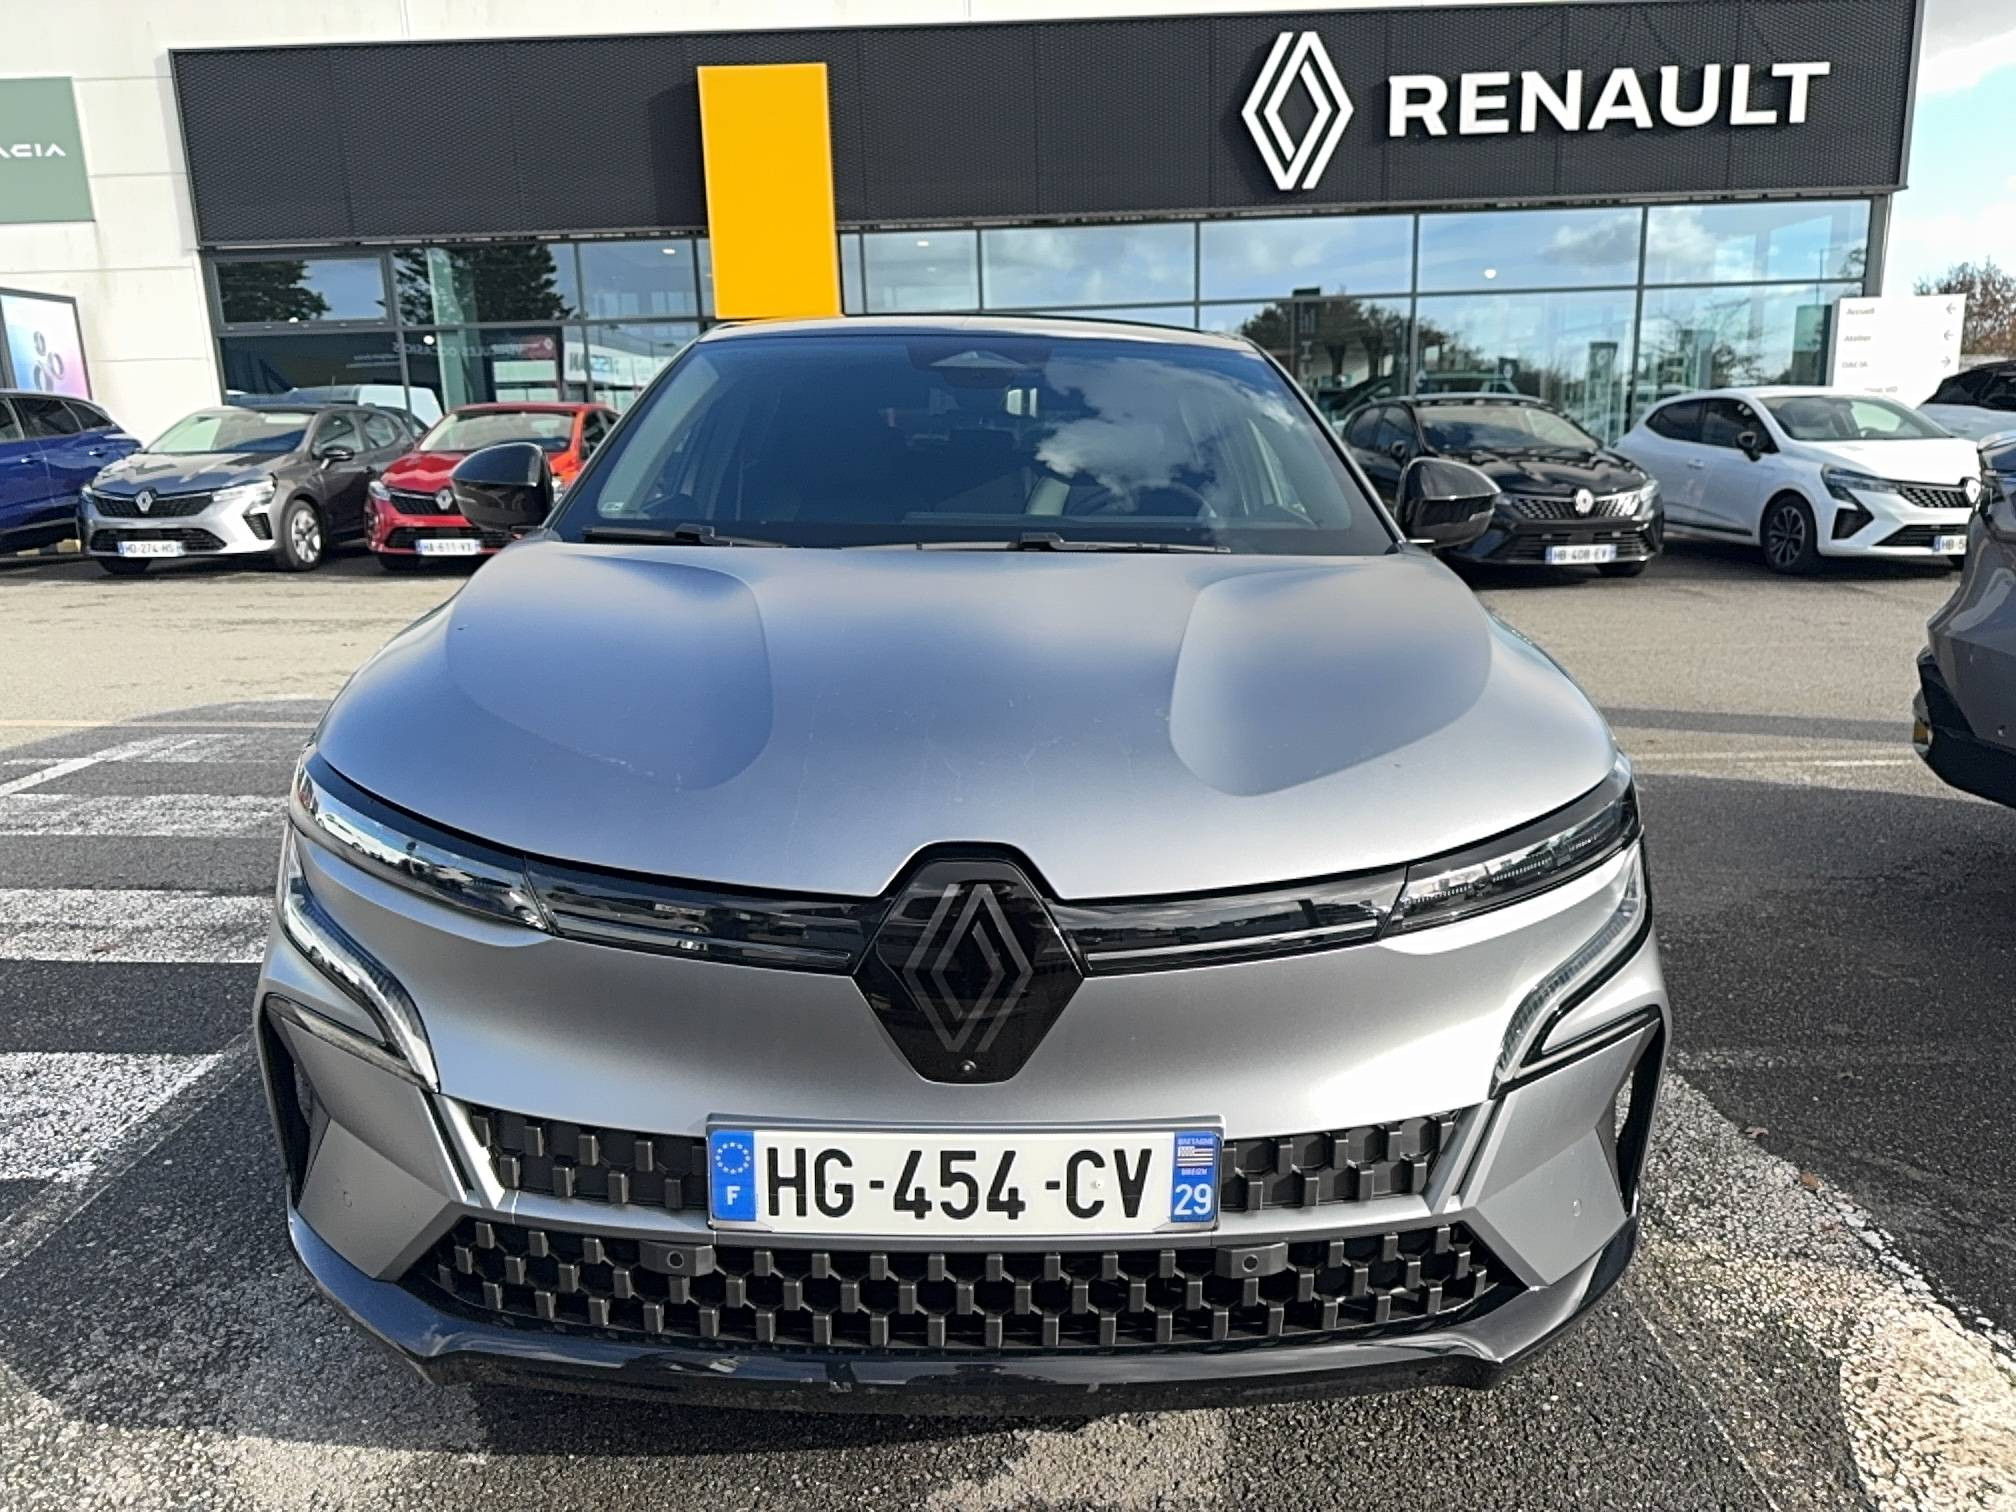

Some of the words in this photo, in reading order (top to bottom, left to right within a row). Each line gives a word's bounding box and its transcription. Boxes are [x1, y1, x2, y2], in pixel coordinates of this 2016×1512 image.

[1388, 61, 1831, 137] RENAULT
[726, 1185, 741, 1206] F
[767, 1147, 1152, 1220] HG-454-CV
[1174, 1182, 1212, 1216] 29
